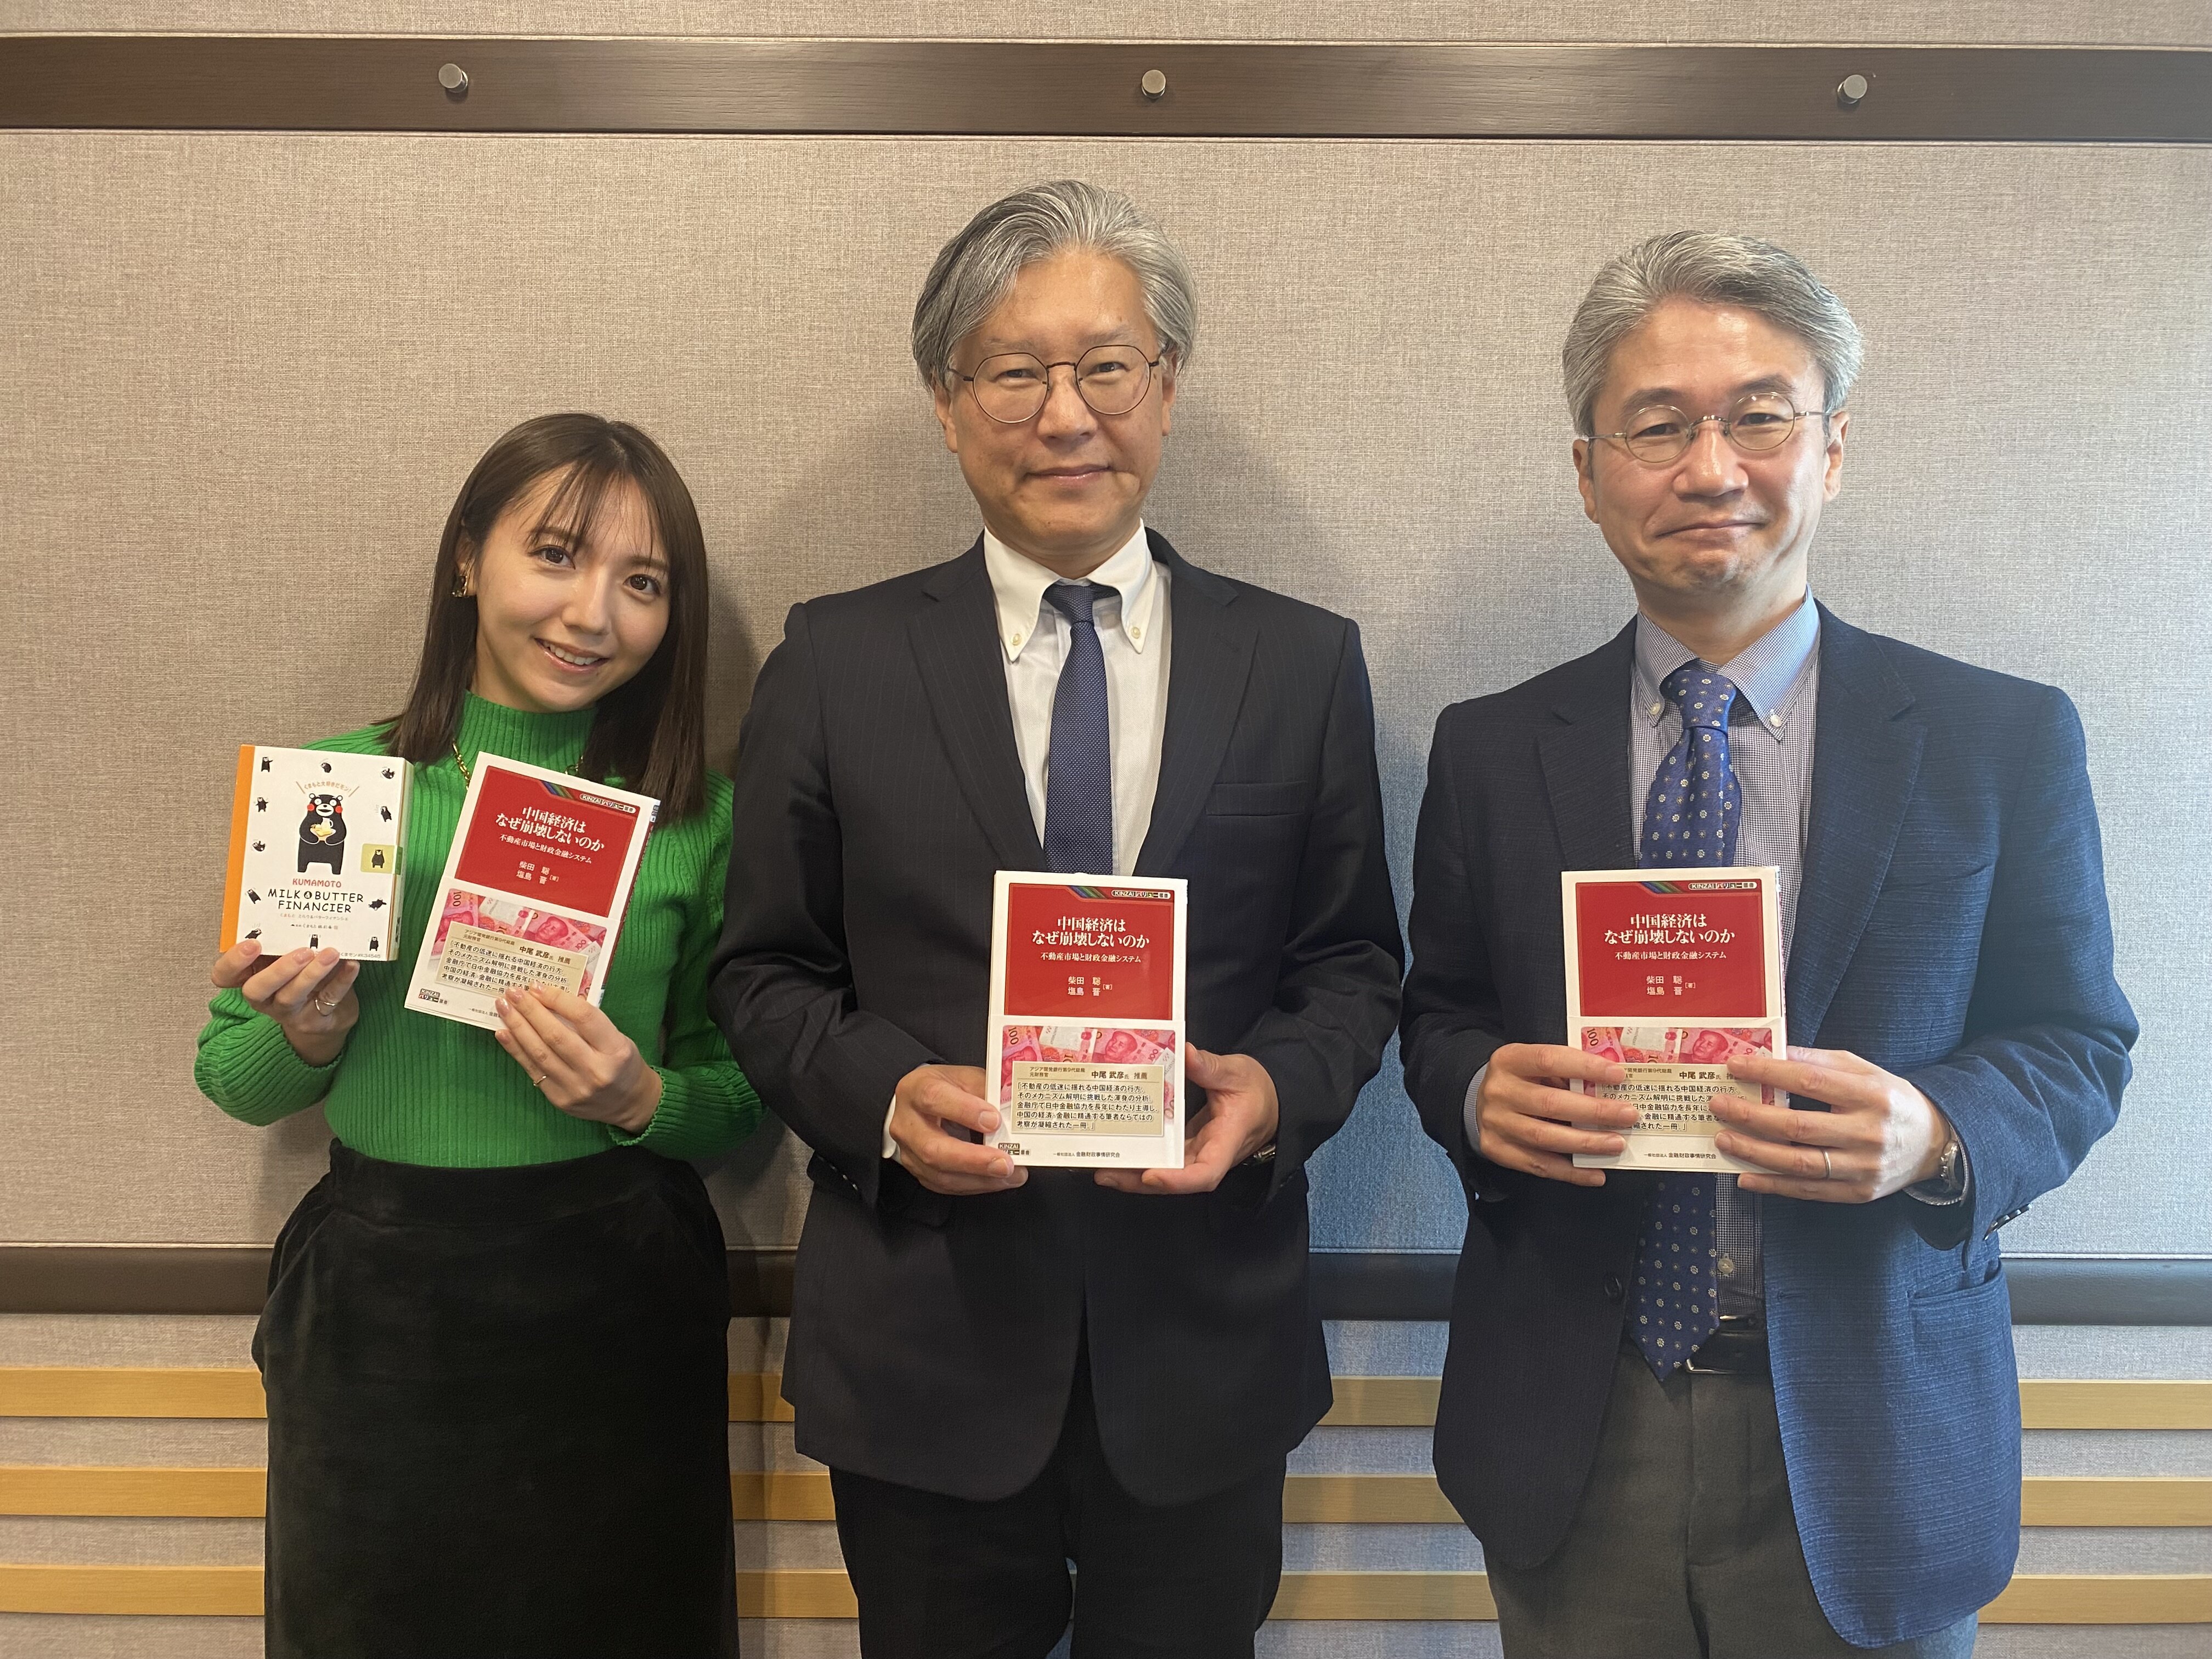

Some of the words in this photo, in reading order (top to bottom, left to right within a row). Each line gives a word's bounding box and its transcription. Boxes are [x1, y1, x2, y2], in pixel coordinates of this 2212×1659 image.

[522, 806, 586, 833] 中国経済は
[495, 812, 605, 852] なぜ崩壊しないのか
[499, 833, 592, 864] 不動産市場と財政金融システム
[519, 861, 535, 871] 柴田
[516, 870, 532, 881] 塩島
[292, 878, 342, 888] KUMAMOTO
[268, 888, 301, 899] MILK
[315, 891, 363, 902] BUTTER
[278, 900, 351, 913] FINANCIER
[1057, 916, 1126, 933] 中国経済は
[1630, 913, 1707, 929] 中国経済は
[1032, 930, 1150, 949] なぜ崩壊しないのか
[1604, 929, 1735, 945] なぜ崩壊しないのか
[520, 945, 534, 956] 中尾
[1615, 951, 1726, 960] 不動産市場と財政金融システム
[1040, 952, 1141, 963] 不動産市場と財政金融システム
[1068, 976, 1085, 985] 柴田
[1092, 977, 1101, 986] 聡
[1646, 975, 1664, 984] 柴田
[1673, 975, 1683, 984] 聡
[421, 989, 440, 997] KINZAI
[1068, 987, 1084, 996] 塩島
[1092, 988, 1101, 996] 晋
[1646, 986, 1664, 996] 塩島
[1673, 986, 1683, 996] 晋
[1008, 1026, 1019, 1045] 100
[1587, 1028, 1599, 1046] 100
[1091, 1071, 1107, 1079] 中尾
[1679, 1071, 1696, 1080] 中尾
